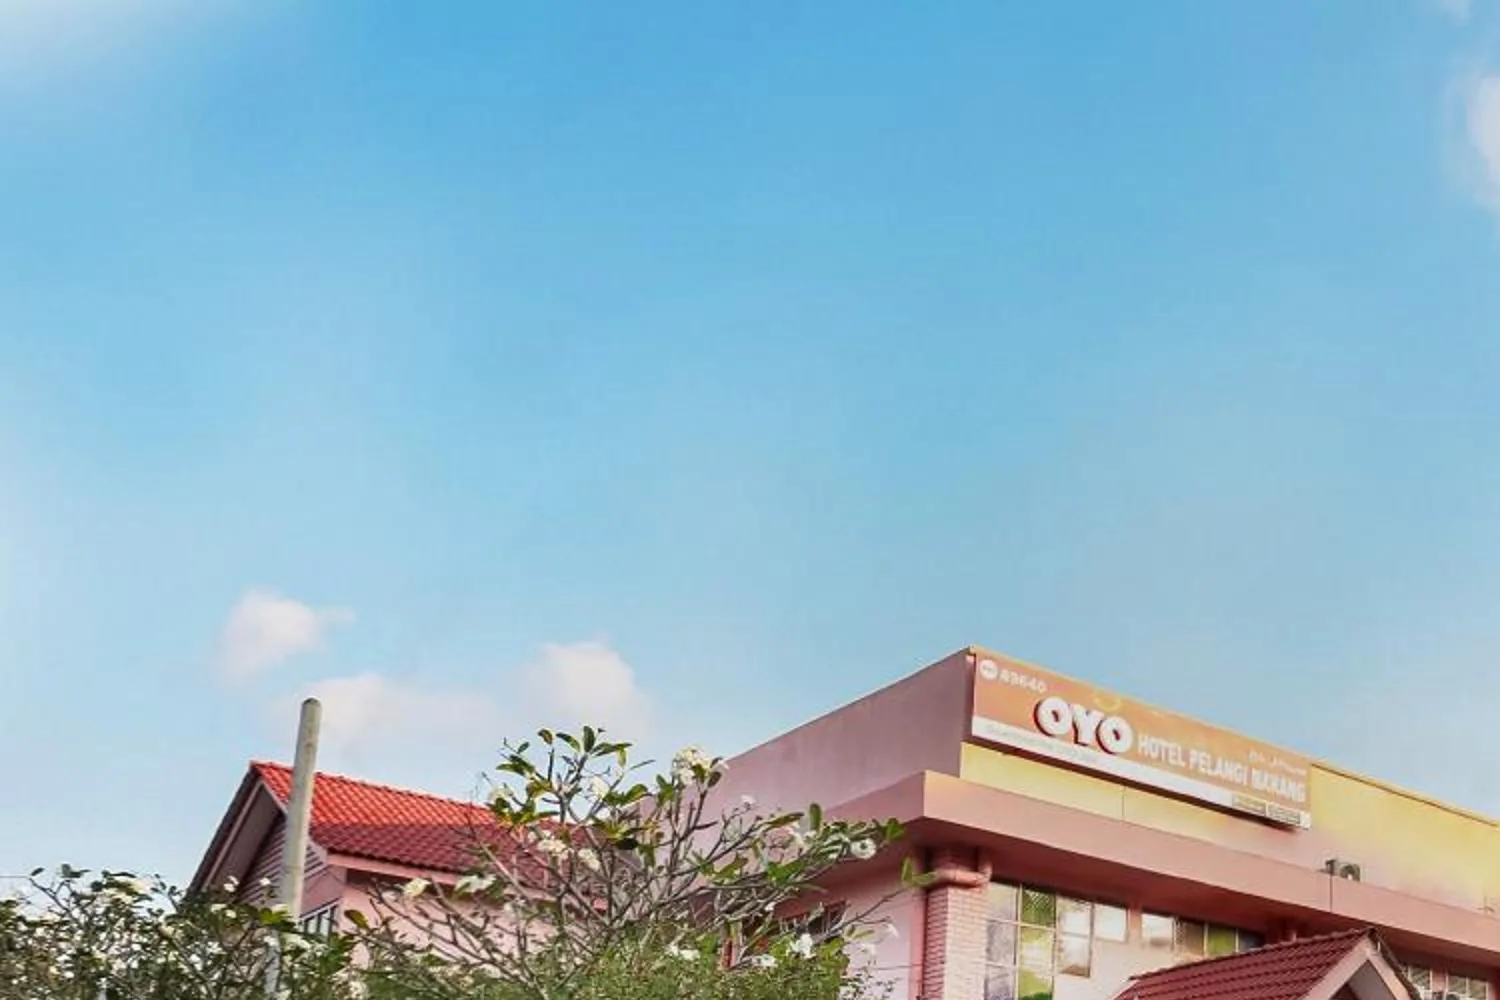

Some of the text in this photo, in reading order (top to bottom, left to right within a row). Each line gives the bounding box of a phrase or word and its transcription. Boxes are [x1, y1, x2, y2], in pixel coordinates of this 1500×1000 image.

[1034, 696, 1134, 754] OYO
[1138, 734, 1187, 766] HOTEL
[1189, 750, 1248, 786] PELANGI
